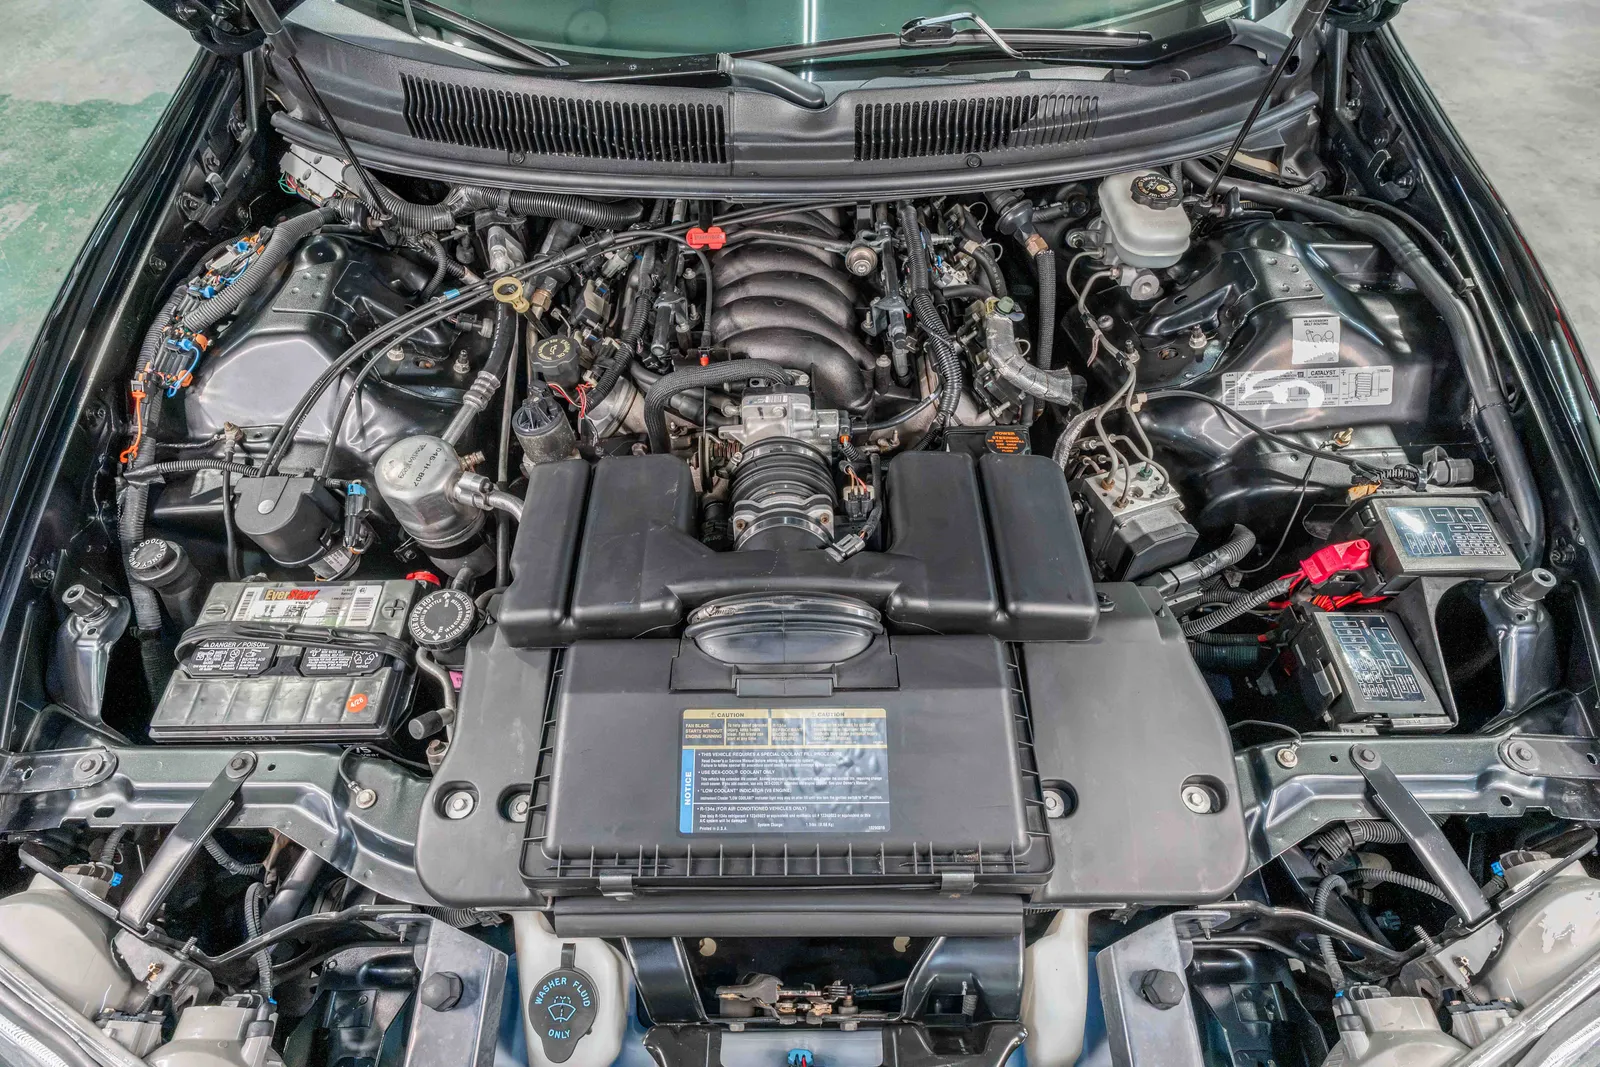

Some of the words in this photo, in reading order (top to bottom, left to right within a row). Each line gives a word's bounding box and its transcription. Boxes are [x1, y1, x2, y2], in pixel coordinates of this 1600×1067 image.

[139, 538, 166, 552] COOLANT
[142, 553, 163, 568] ONLY
[264, 589, 320, 601] EverStart
[421, 595, 435, 607] HOT
[412, 606, 424, 622] OPEN
[412, 622, 427, 639] NEVER
[684, 771, 692, 806] NOTICE
[535, 976, 567, 1005] WASHER
[572, 980, 591, 1007] FLUID
[548, 1029, 571, 1039] ONLY
